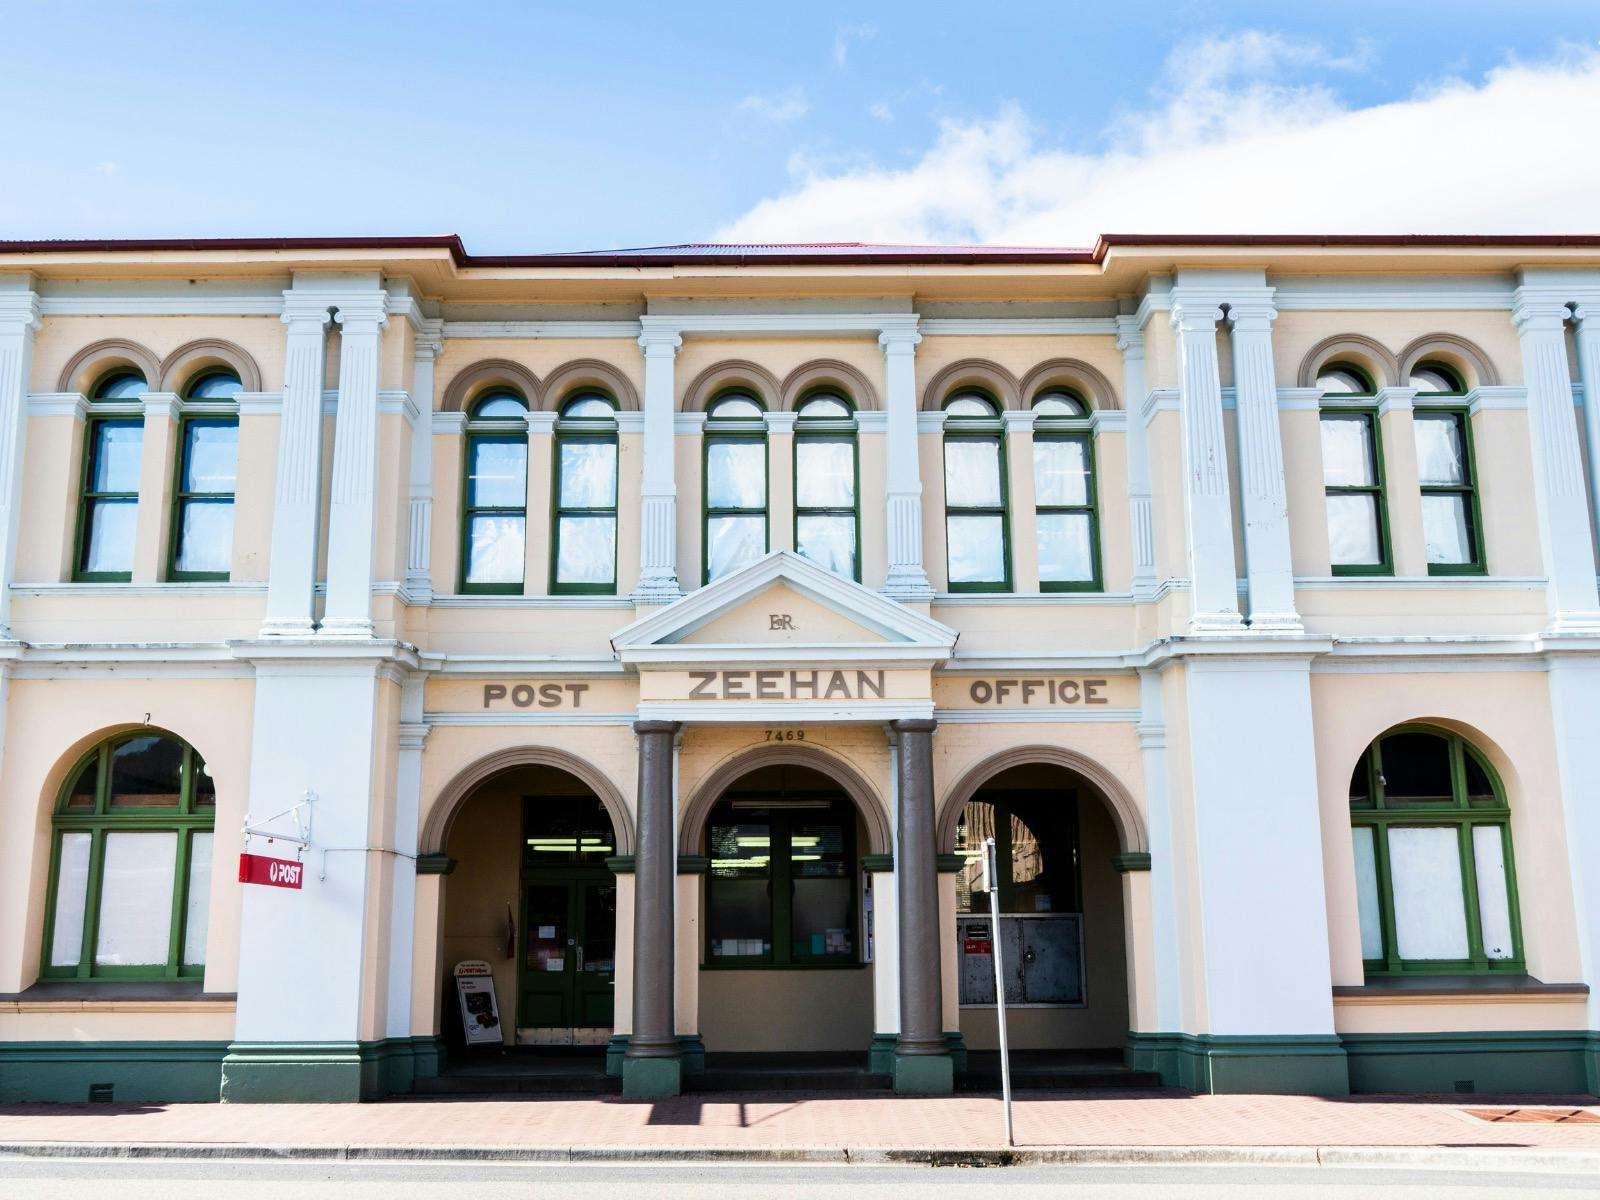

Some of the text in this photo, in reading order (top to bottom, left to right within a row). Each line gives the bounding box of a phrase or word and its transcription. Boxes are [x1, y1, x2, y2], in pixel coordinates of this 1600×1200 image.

[483, 684, 590, 709] POST
[688, 670, 886, 700] ZEEHAN
[969, 679, 1109, 705] OFFICE
[765, 730, 805, 742] 7469
[279, 864, 301, 884] POST
